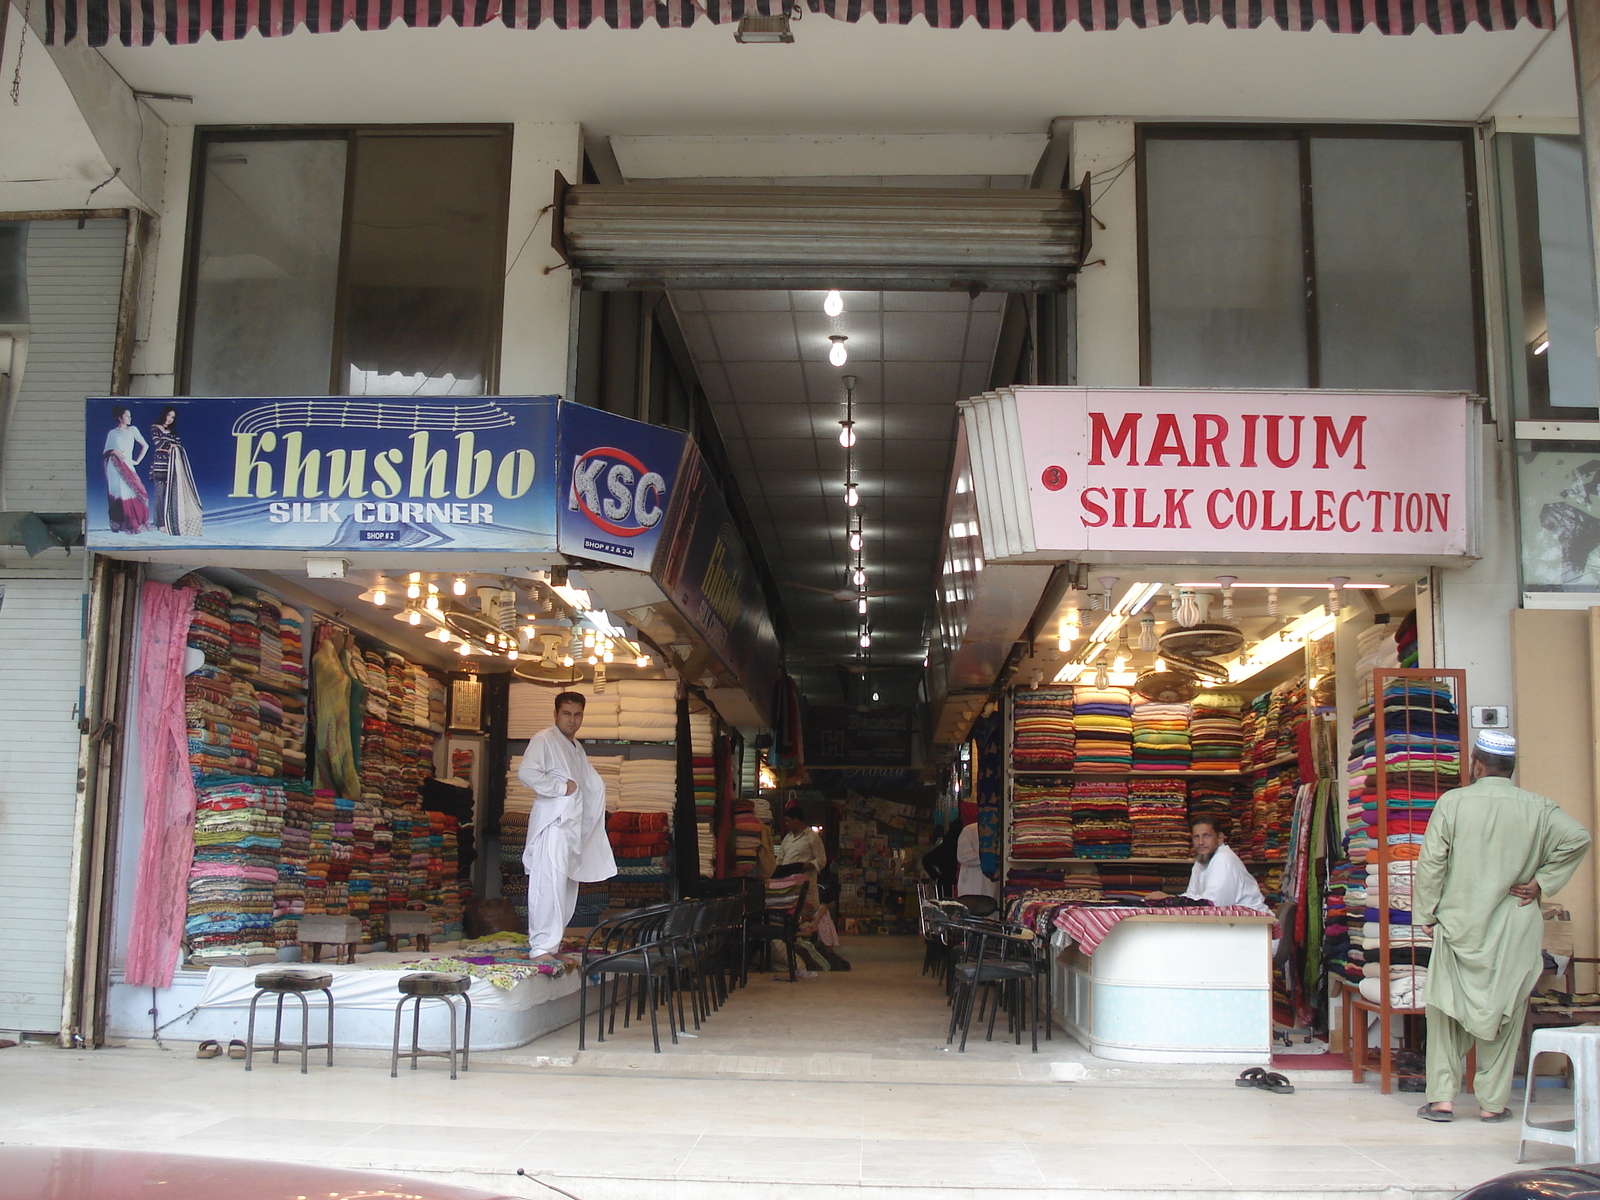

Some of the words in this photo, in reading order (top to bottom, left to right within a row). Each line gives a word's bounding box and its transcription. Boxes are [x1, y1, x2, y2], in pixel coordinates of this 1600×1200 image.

[1087, 411, 1367, 470] MARIUM
[227, 430, 536, 500] Khushbo
[268, 501, 343, 524] SILK
[353, 501, 494, 525] CORNER
[568, 455, 667, 530] KSC
[1080, 486, 1195, 530] SILK
[1206, 487, 1451, 533] COLLECTION
[366, 532, 384, 540] SHOP
[390, 532, 395, 540] 2
[585, 541, 604, 549] SHOP
